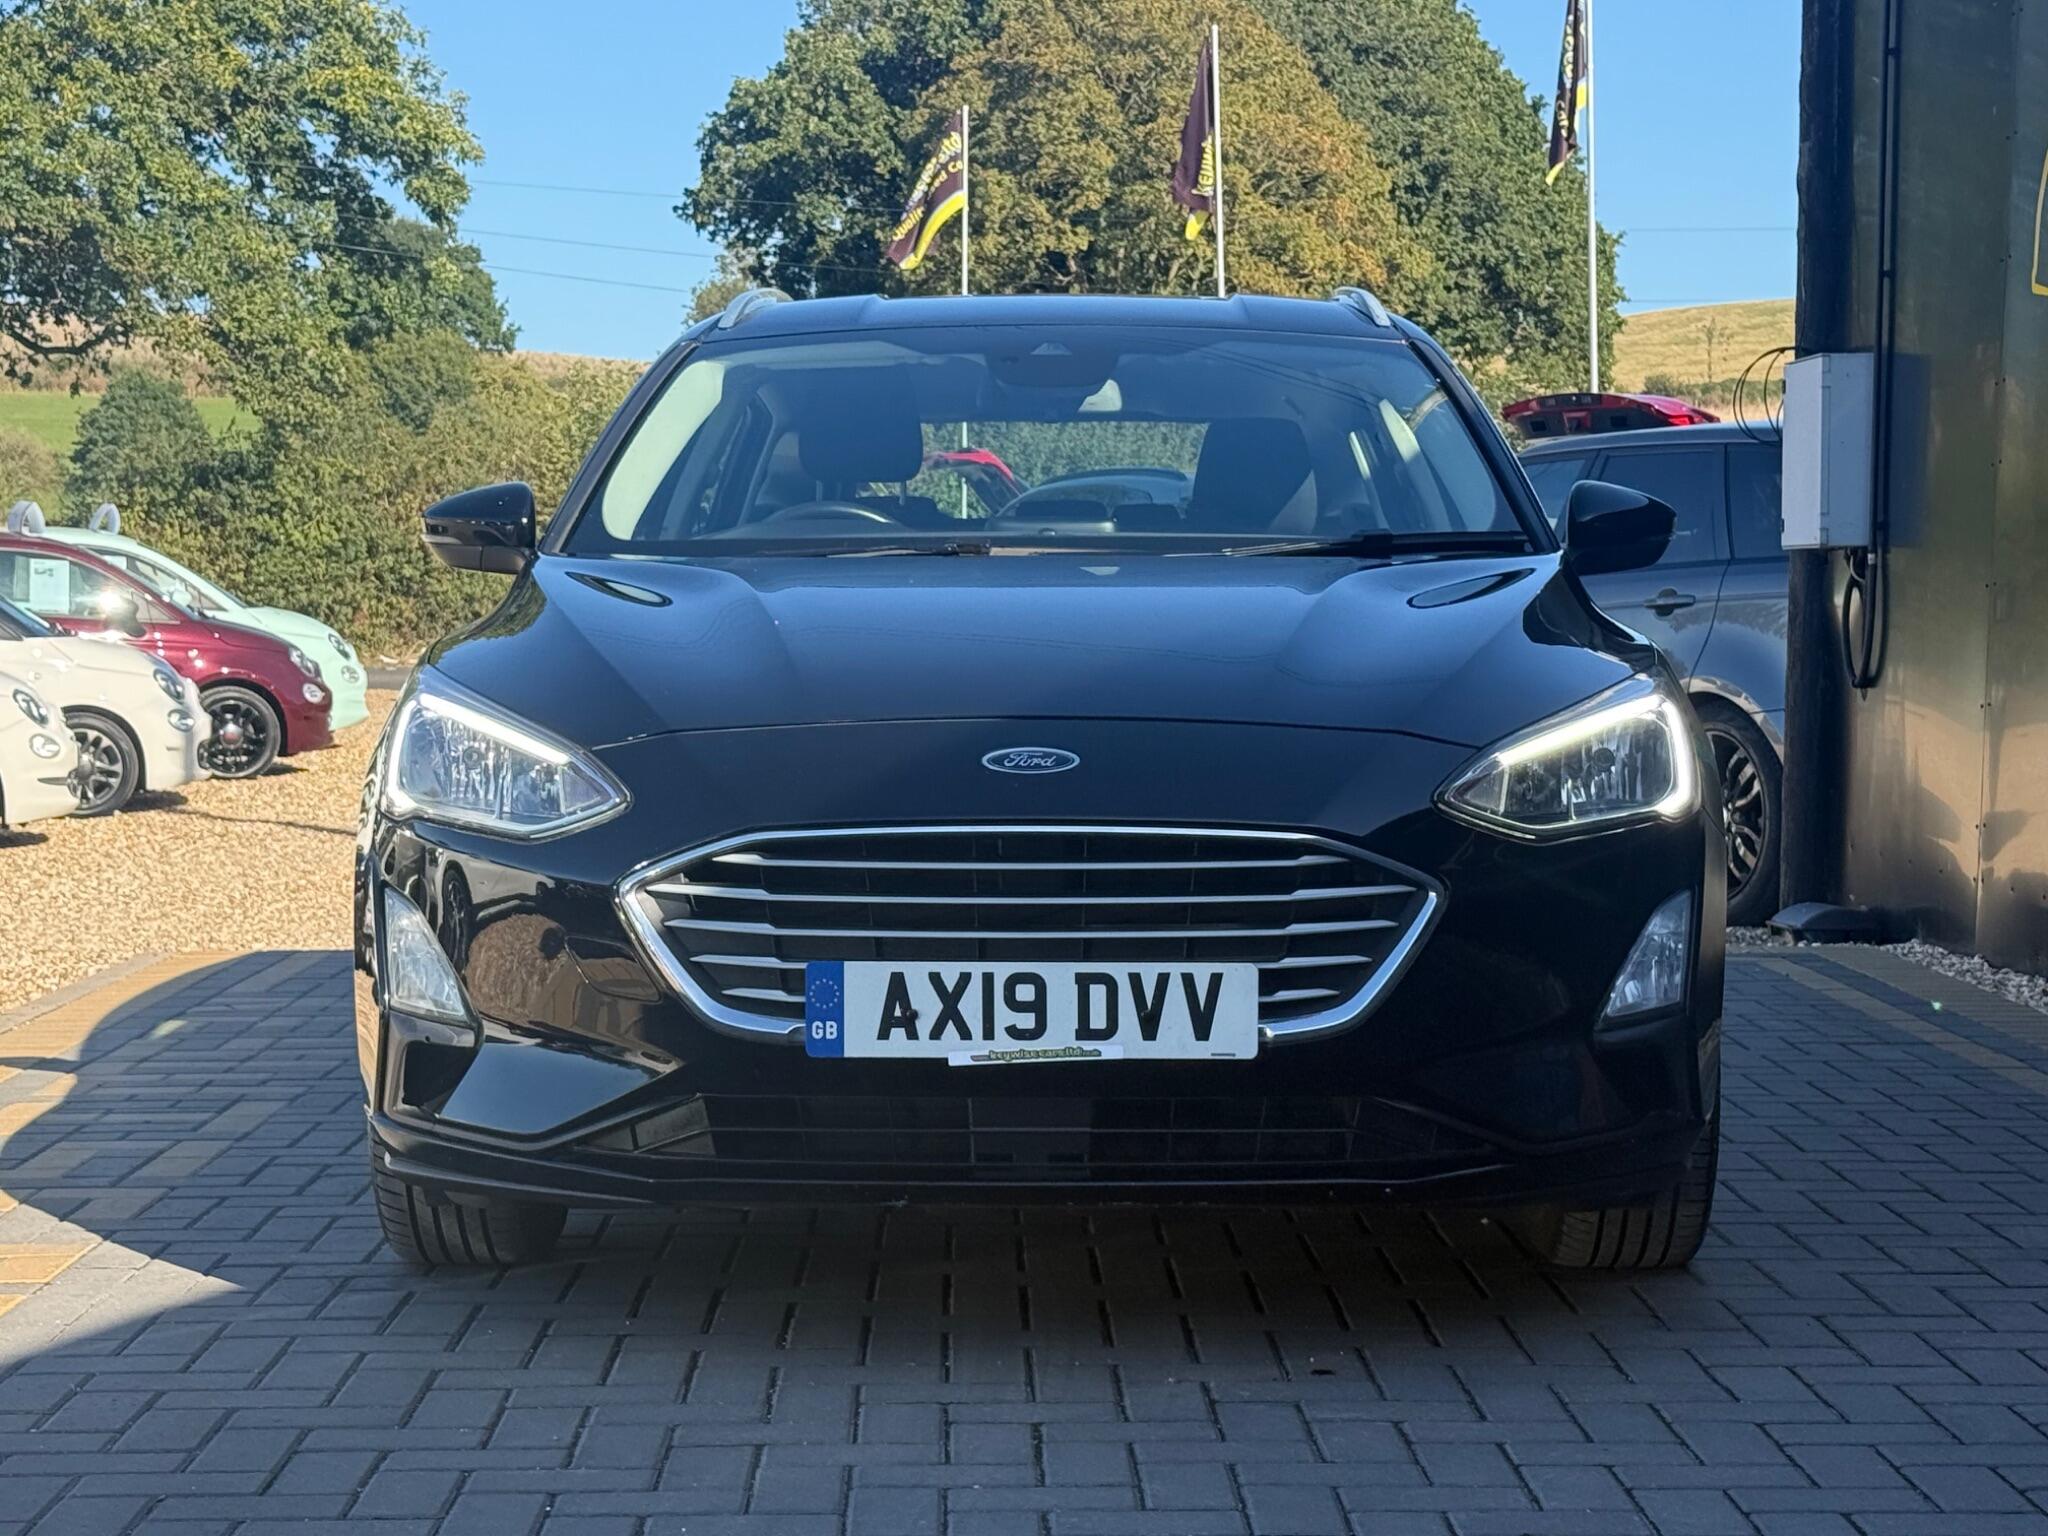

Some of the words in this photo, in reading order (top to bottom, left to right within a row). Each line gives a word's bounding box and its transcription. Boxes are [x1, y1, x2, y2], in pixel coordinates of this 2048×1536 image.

[1004, 752, 1056, 767] Ford
[876, 971, 1047, 1041] AX19
[1074, 972, 1224, 1041] DVV
[811, 1020, 838, 1040] GB
